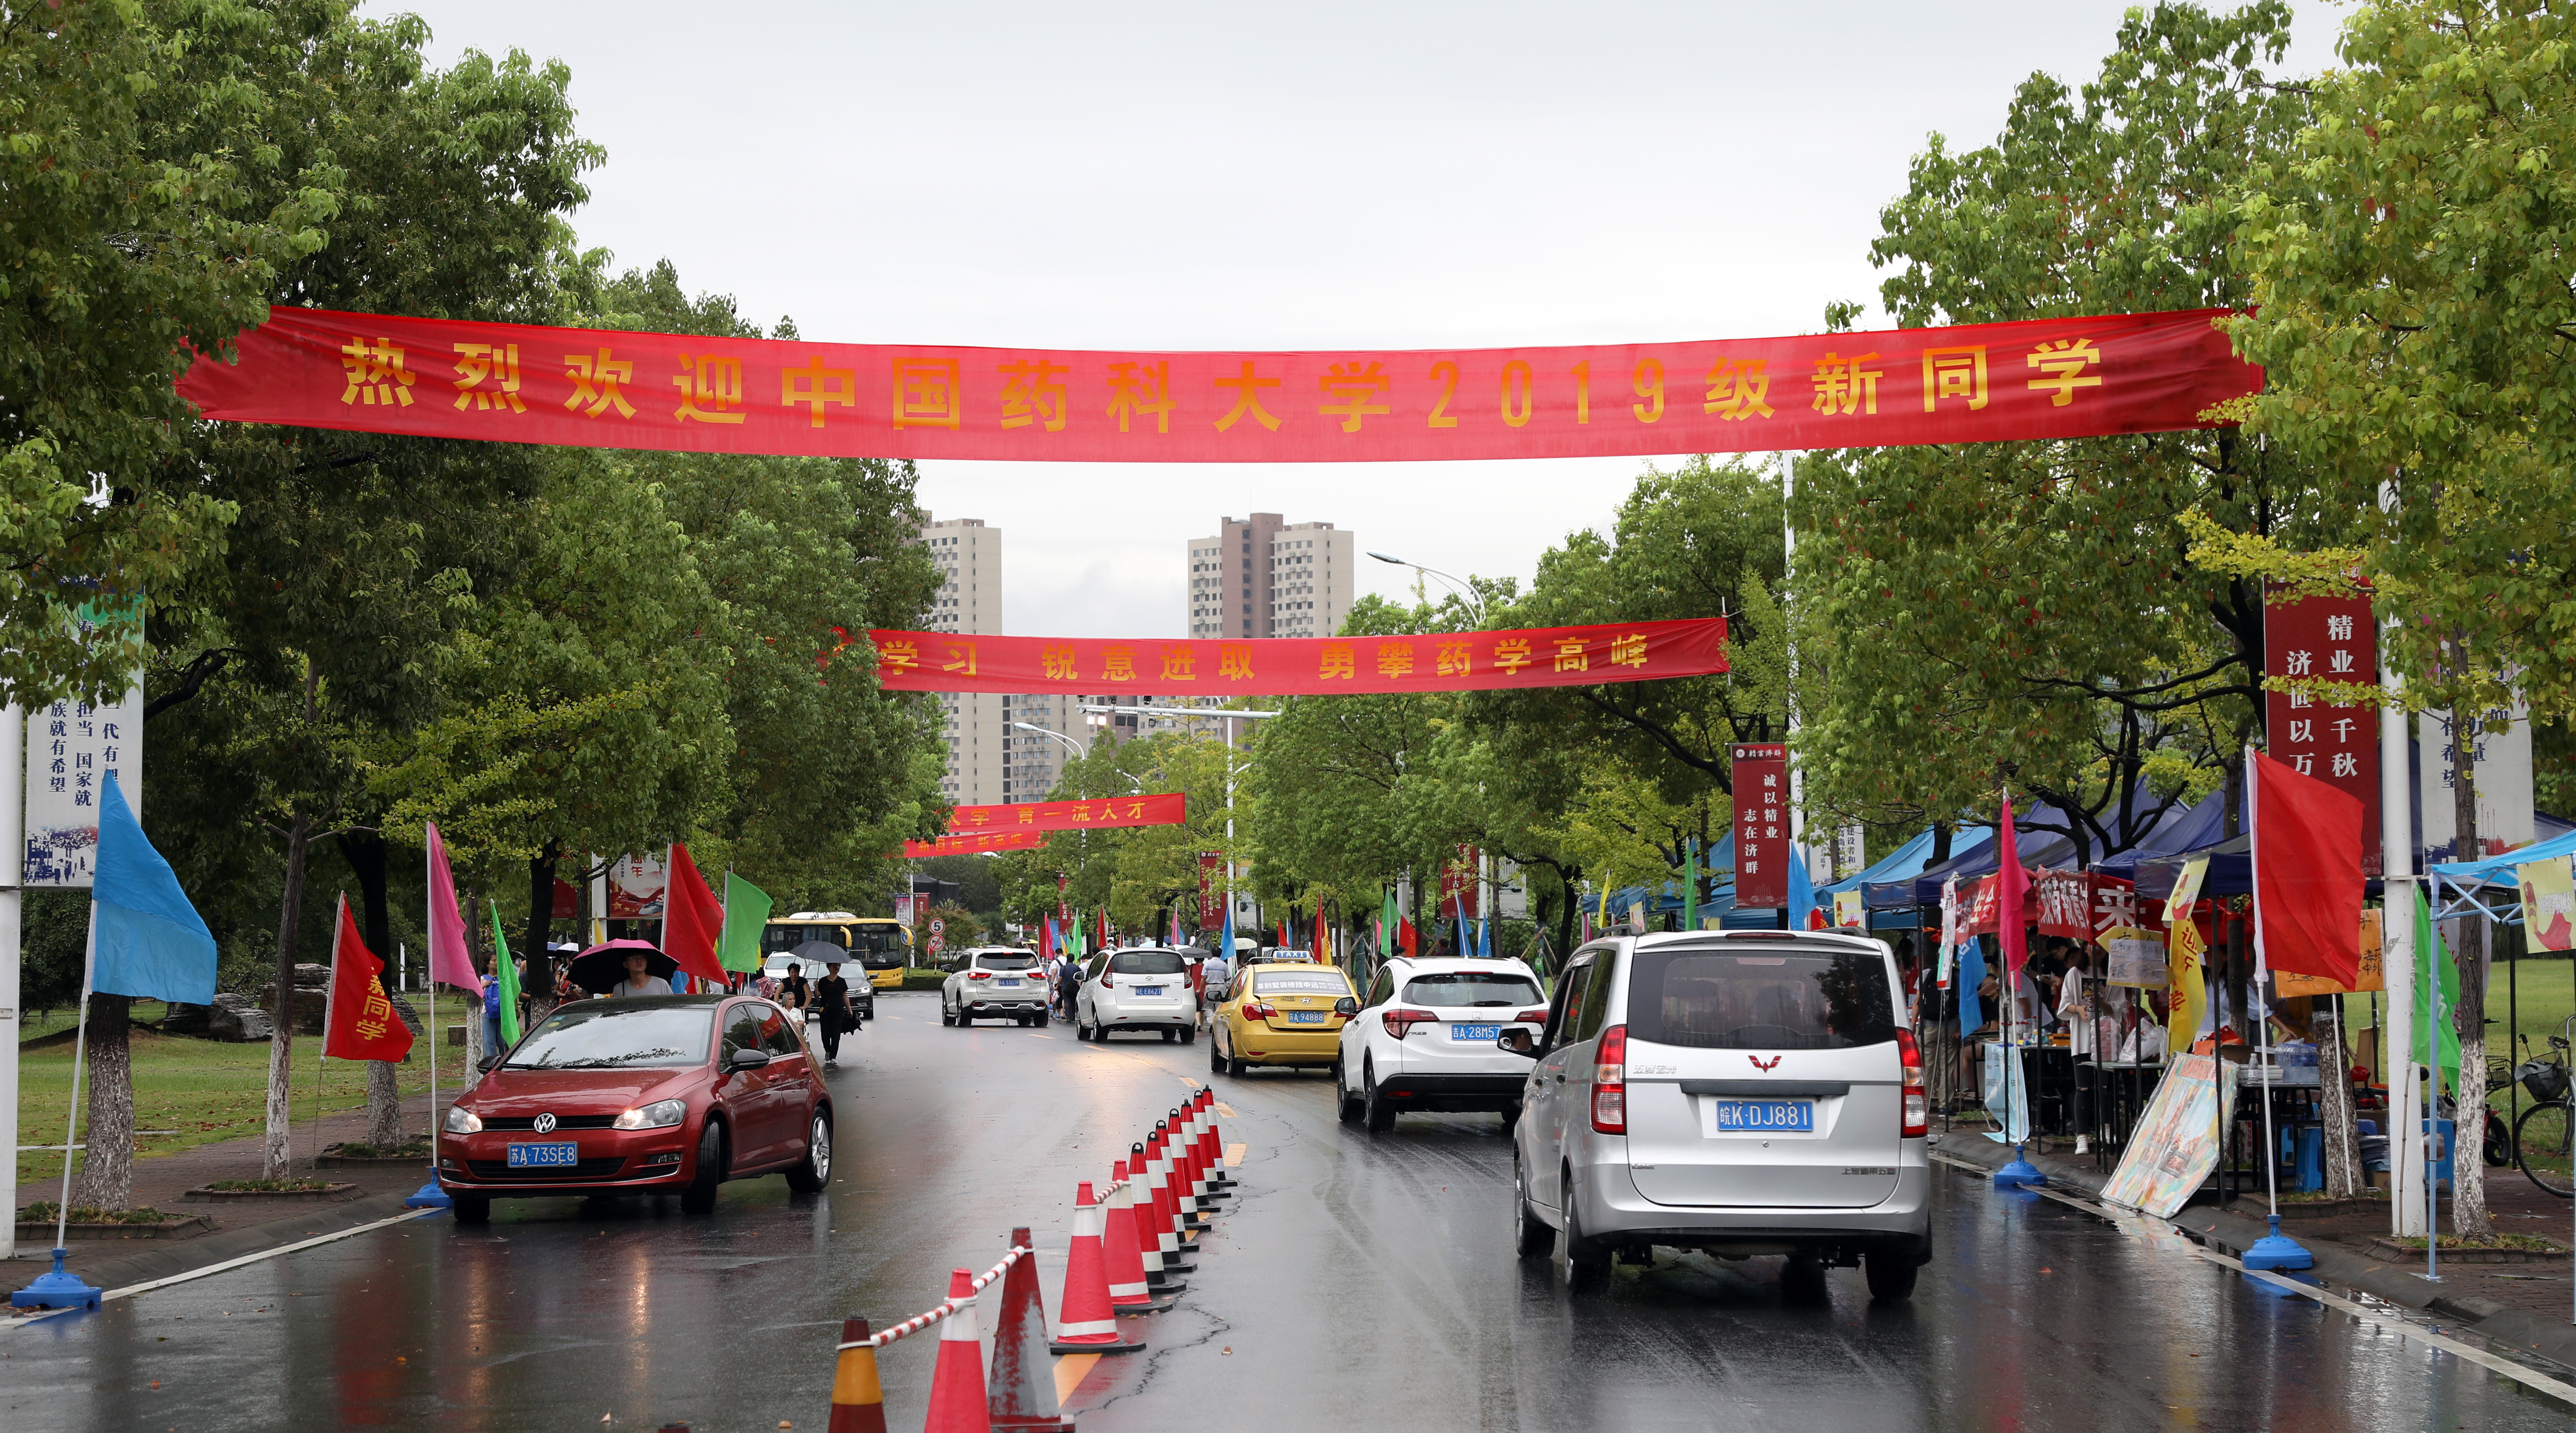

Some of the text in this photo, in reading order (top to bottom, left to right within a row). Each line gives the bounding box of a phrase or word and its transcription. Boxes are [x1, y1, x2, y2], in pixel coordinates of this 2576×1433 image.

[342, 336, 2103, 434] 热烈欢迎中国药科大学2019级新同学
[1041, 643, 1256, 681] 锐意进取
[1318, 634, 1649, 681] 勇攀药学高峰
[49, 695, 67, 793] 族就有希望
[1017, 801, 1146, 824] 育一流人才
[1763, 774, 1778, 839] 诚以精业
[1744, 808, 1759, 874] 志在济群
[934, 922, 940, 931] 5
